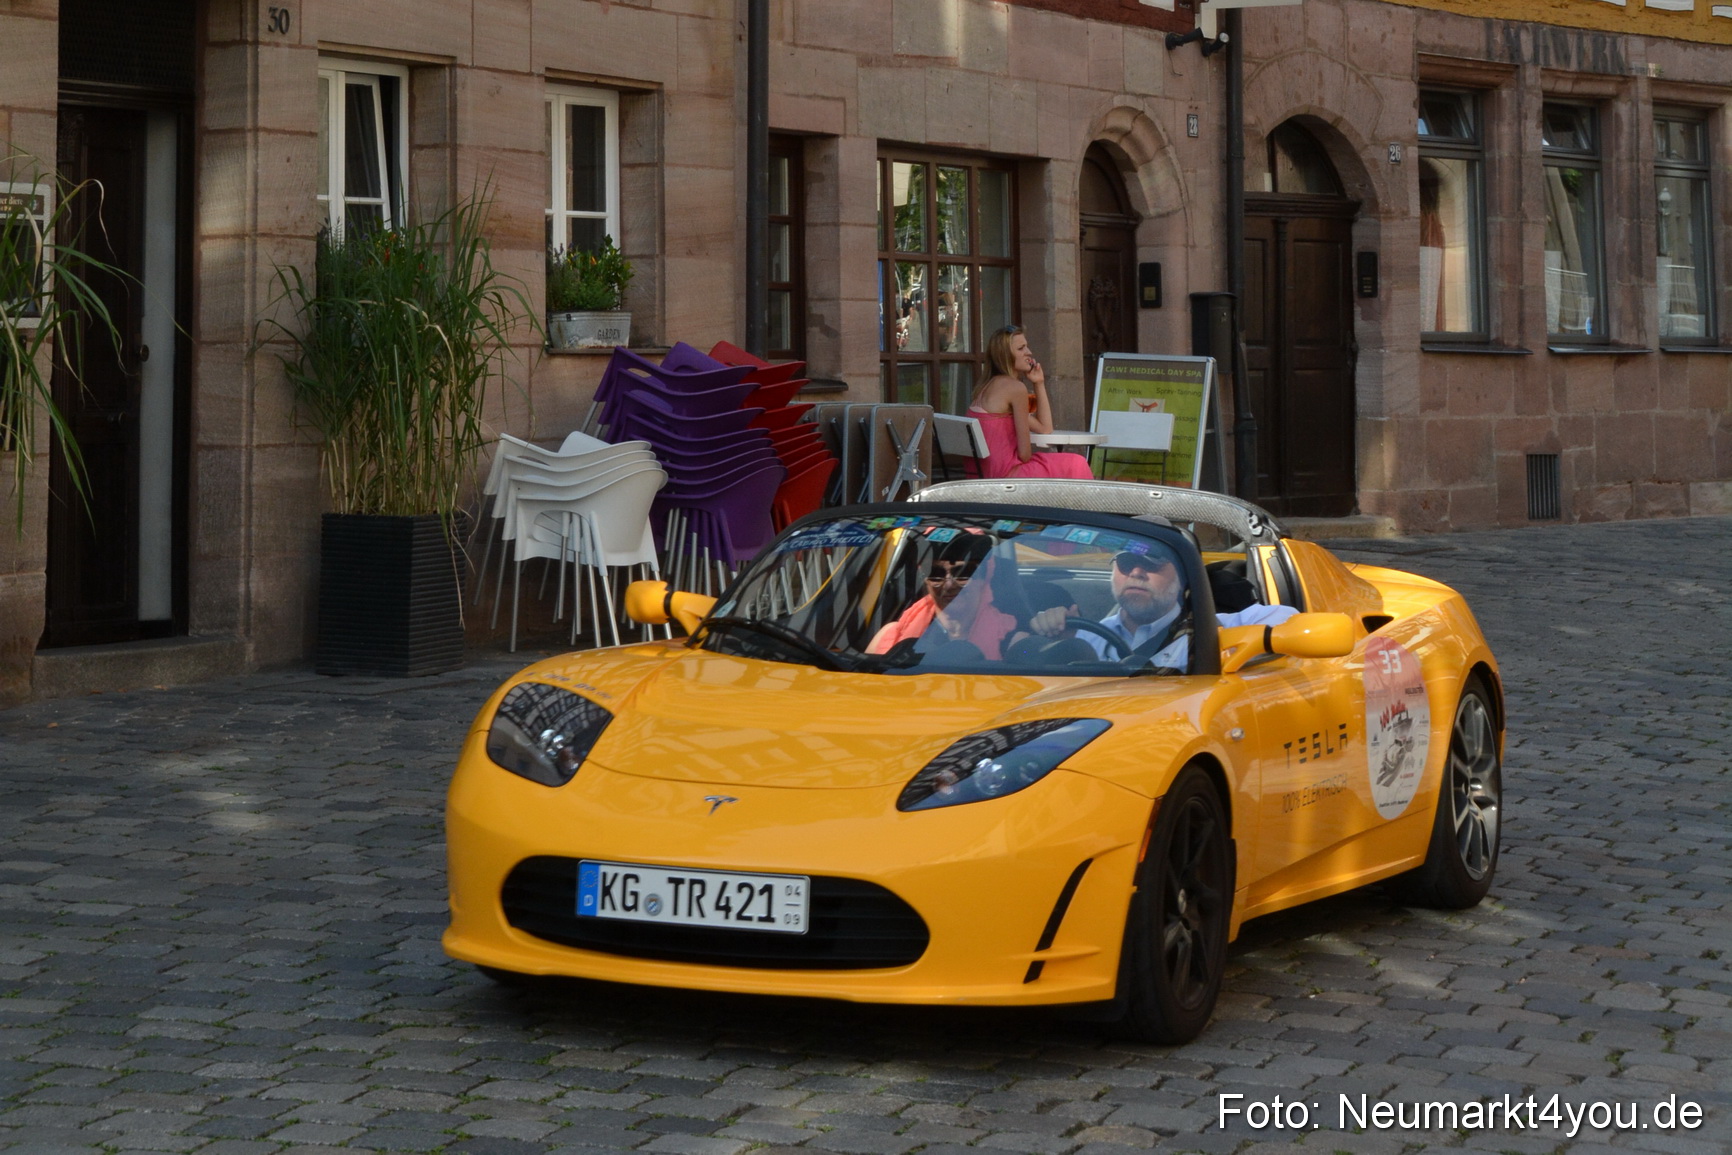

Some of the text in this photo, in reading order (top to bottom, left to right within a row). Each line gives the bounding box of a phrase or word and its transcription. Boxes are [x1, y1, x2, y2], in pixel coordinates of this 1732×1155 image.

[267, 7, 290, 34] 30
[1189, 117, 1198, 135] 28
[1389, 145, 1401, 161] 26
[597, 328, 622, 340] GARDEN
[1129, 367, 1166, 376] MEDICAL
[1167, 369, 1185, 377] DAY
[829, 534, 877, 544] TREFFEN
[1378, 649, 1402, 674] 33
[1283, 723, 1348, 769] TESLA
[1282, 773, 1348, 814] 100% ELEKTRISCH
[583, 871, 776, 923] D KG TR 421
[784, 884, 801, 897] 04
